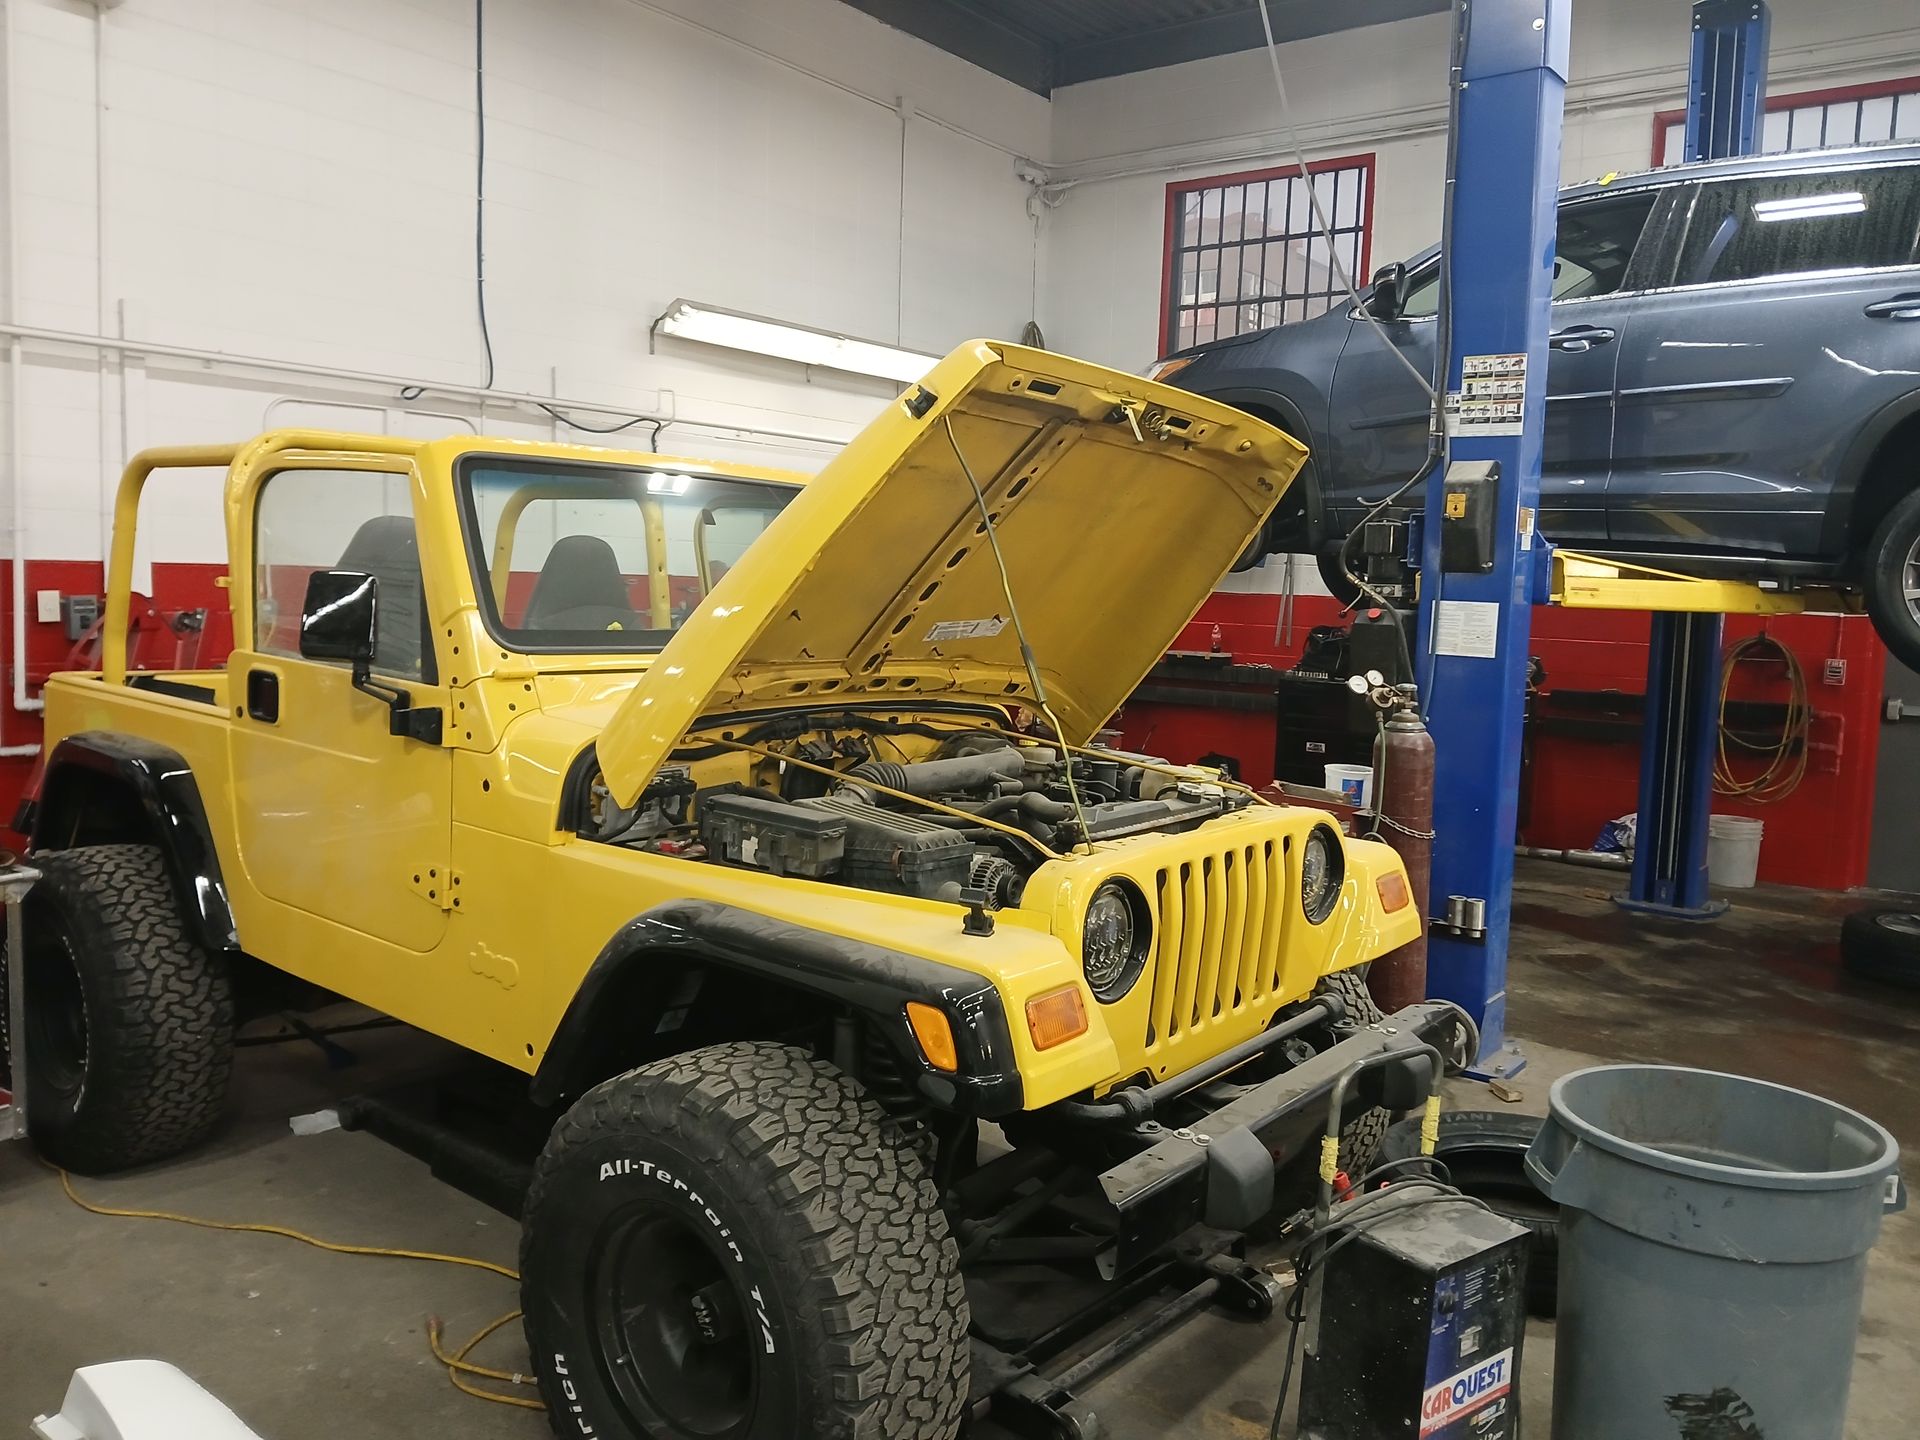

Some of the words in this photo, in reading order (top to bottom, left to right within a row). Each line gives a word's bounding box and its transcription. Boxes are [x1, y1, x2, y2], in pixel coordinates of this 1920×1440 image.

[599, 1159, 743, 1263] All-Terrain
[749, 1284, 776, 1354] T/A
[553, 1353, 598, 1440] rich
[1422, 1358, 1505, 1421] CARQUEST
